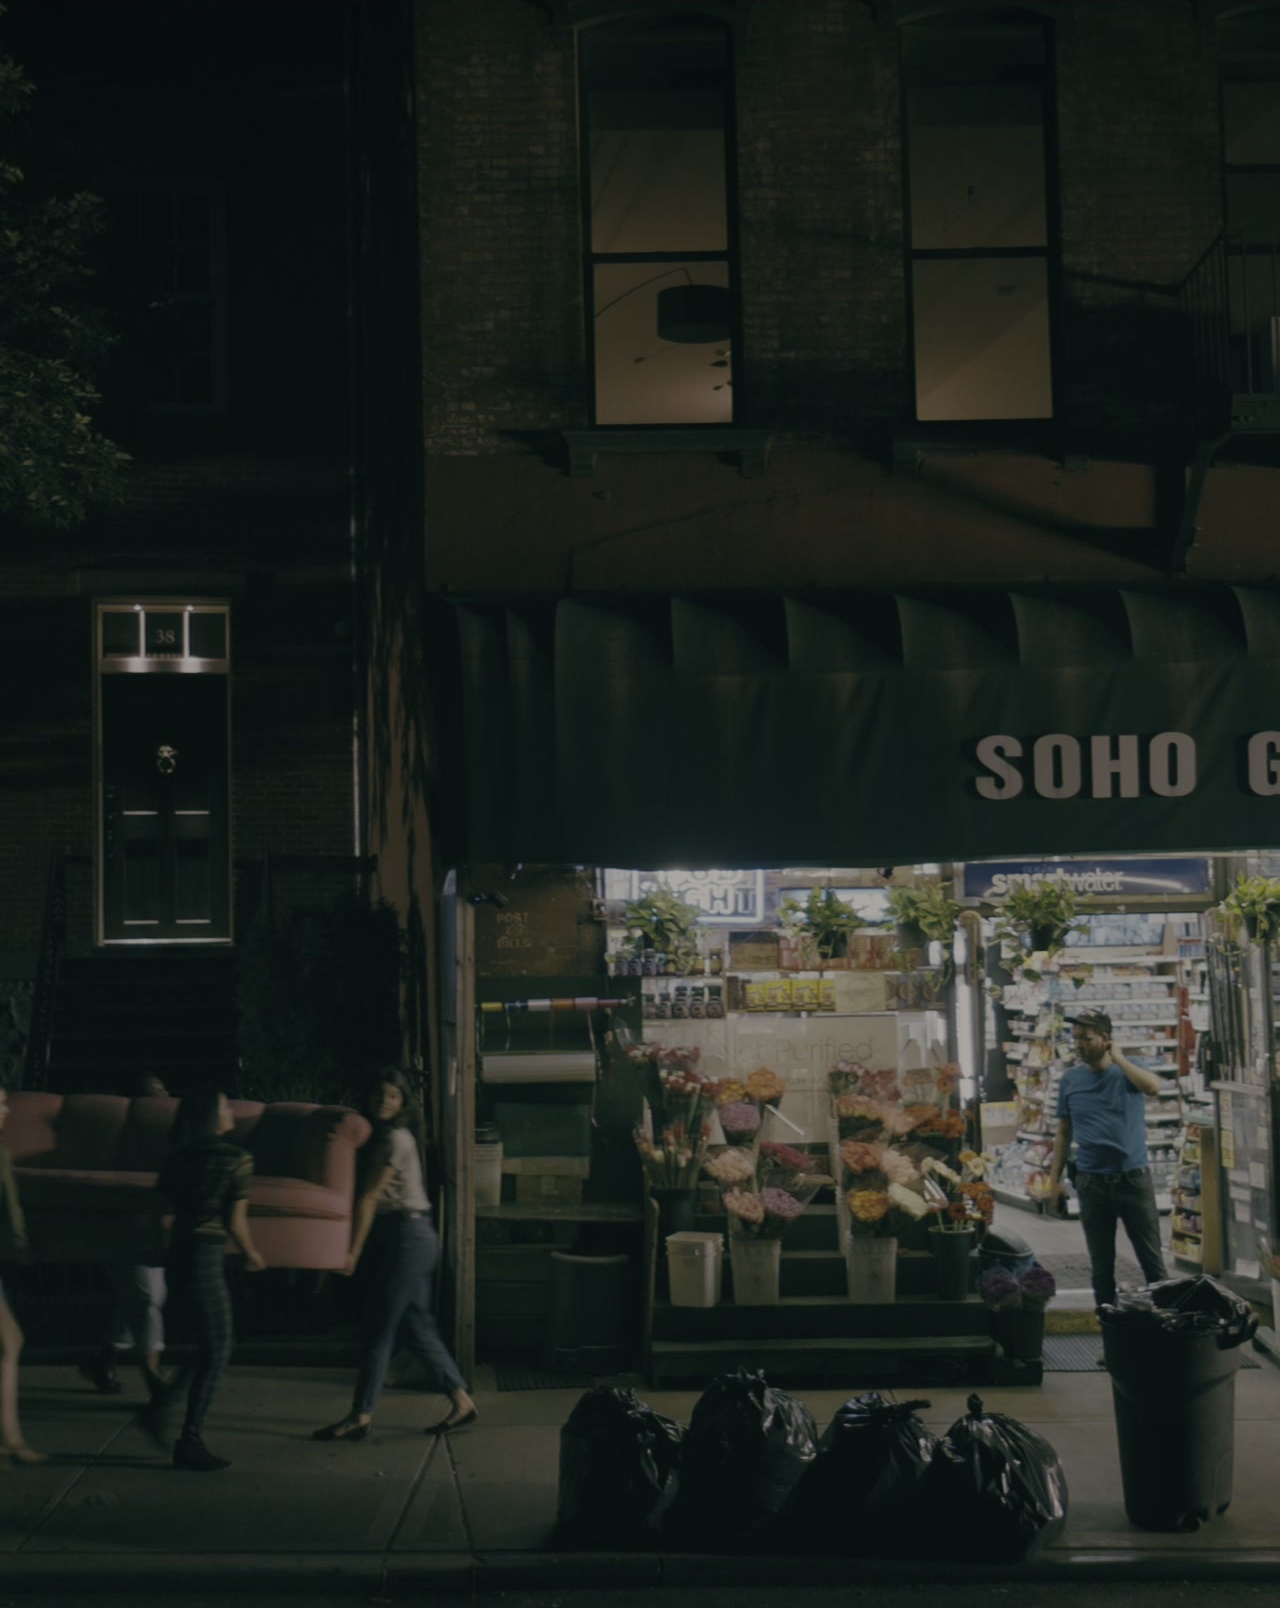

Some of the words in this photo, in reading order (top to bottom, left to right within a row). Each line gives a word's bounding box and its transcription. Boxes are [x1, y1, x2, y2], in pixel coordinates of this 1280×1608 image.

[155, 629, 176, 644] 38
[974, 731, 1196, 801] SOHO
[497, 912, 529, 924] POST
[497, 937, 532, 949] BILLS
[776, 1038, 870, 1063] Purified
